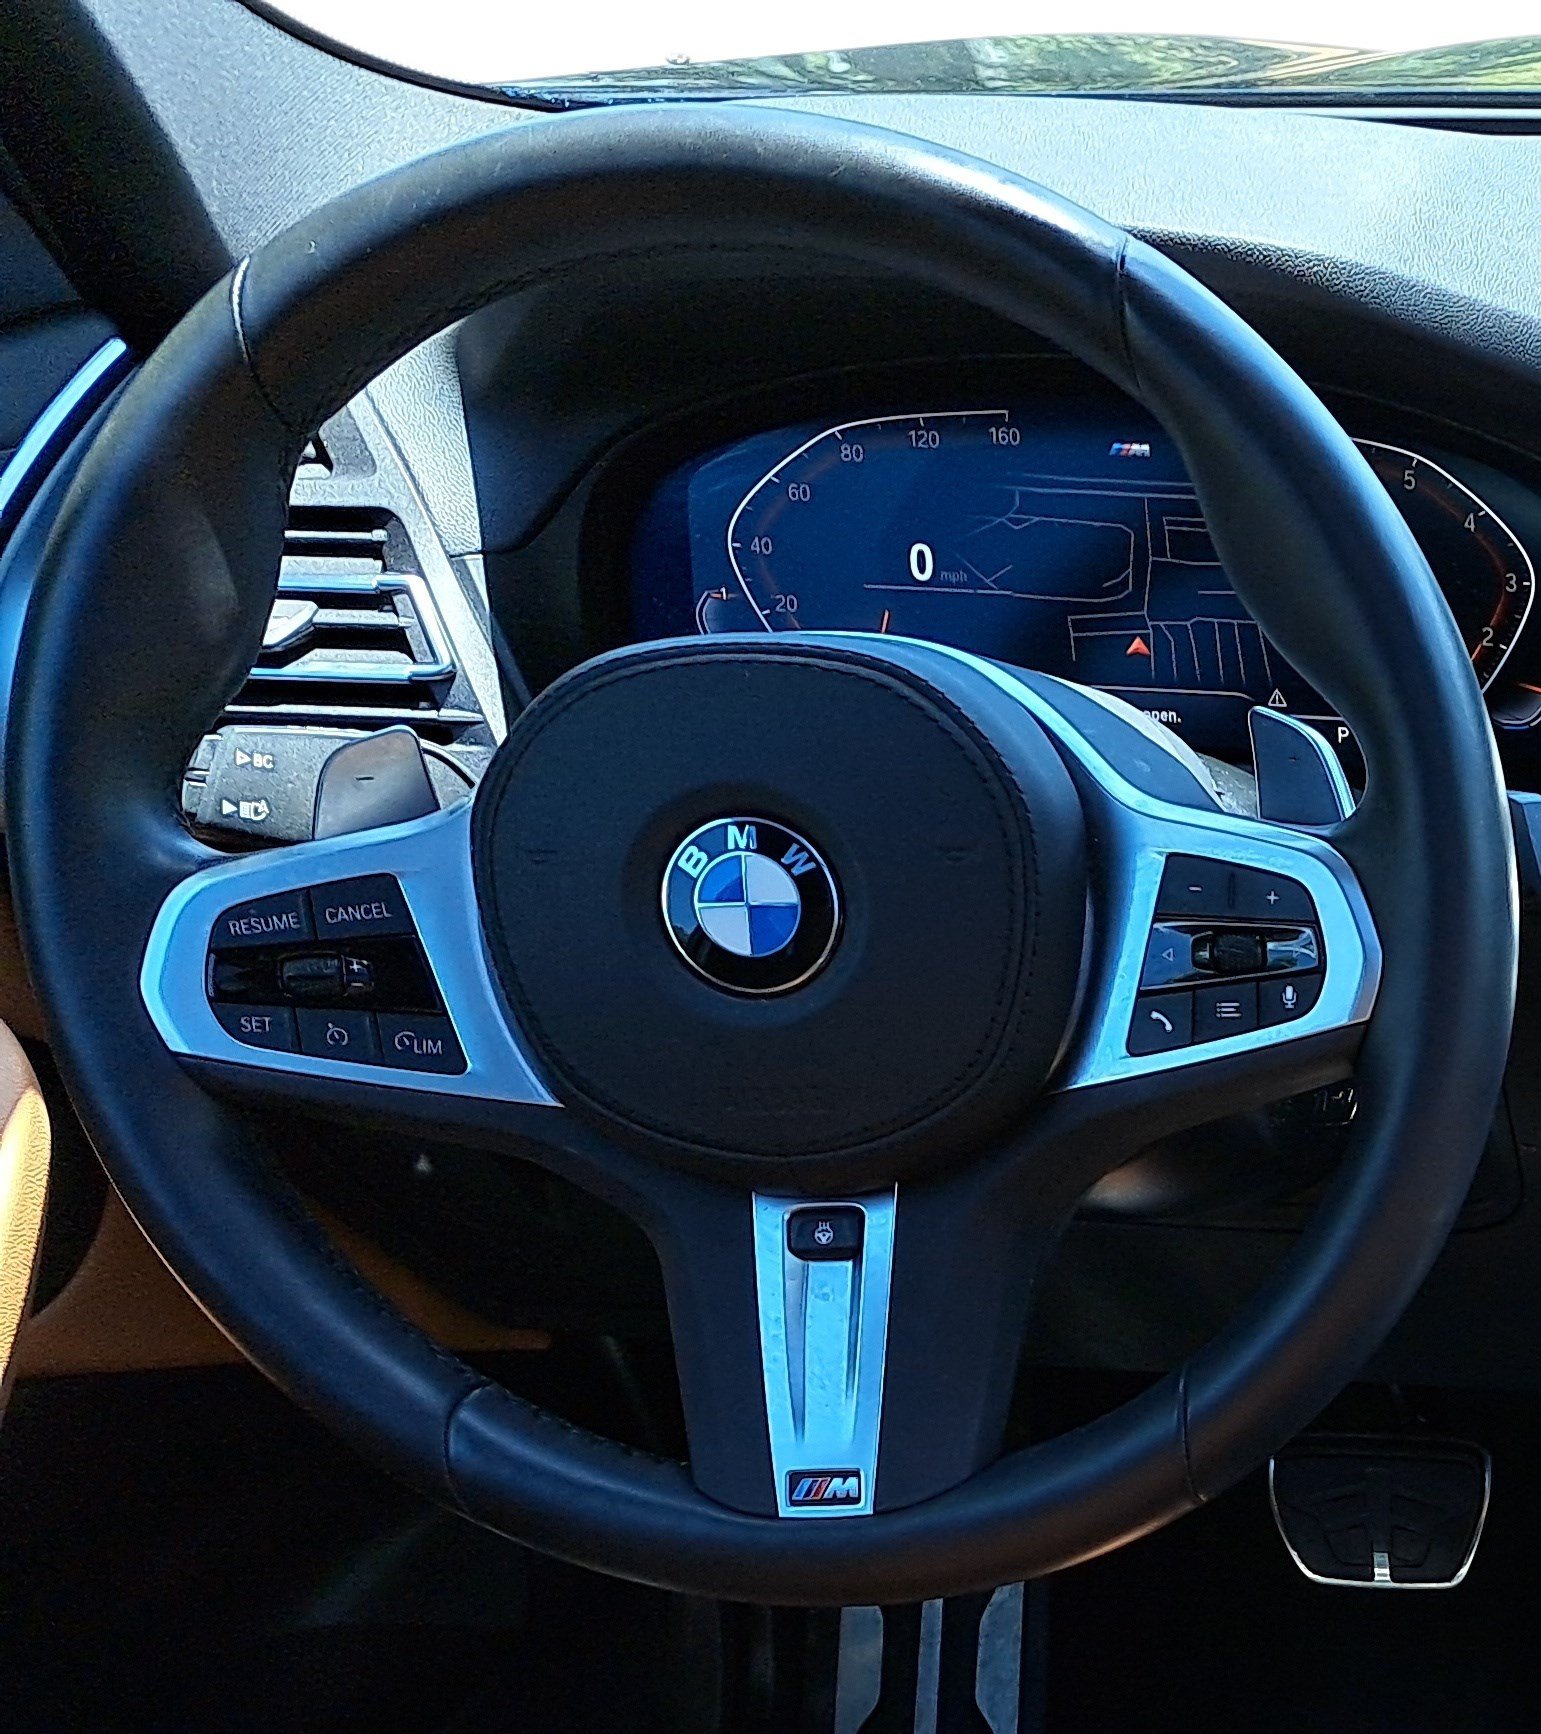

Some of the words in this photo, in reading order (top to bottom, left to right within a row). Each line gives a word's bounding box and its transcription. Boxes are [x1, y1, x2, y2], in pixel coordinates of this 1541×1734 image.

[908, 430, 940, 448] 120
[988, 427, 1020, 445] 160
[840, 444, 864, 462] 80
[1403, 470, 1416, 490] 5
[788, 484, 811, 502] 60
[1464, 514, 1476, 533] 4
[750, 536, 772, 555] 40
[909, 542, 934, 581] 0
[940, 570, 968, 583] mph
[1505, 573, 1517, 592] 3
[774, 595, 798, 613] 20
[1482, 627, 1494, 647] 2
[1337, 727, 1349, 743] P
[252, 752, 274, 769] BC
[677, 824, 817, 879] BMW
[325, 902, 392, 924] CANCEL
[229, 912, 300, 936] RESUME
[240, 1016, 272, 1032] SET
[413, 1038, 442, 1055] LIM
